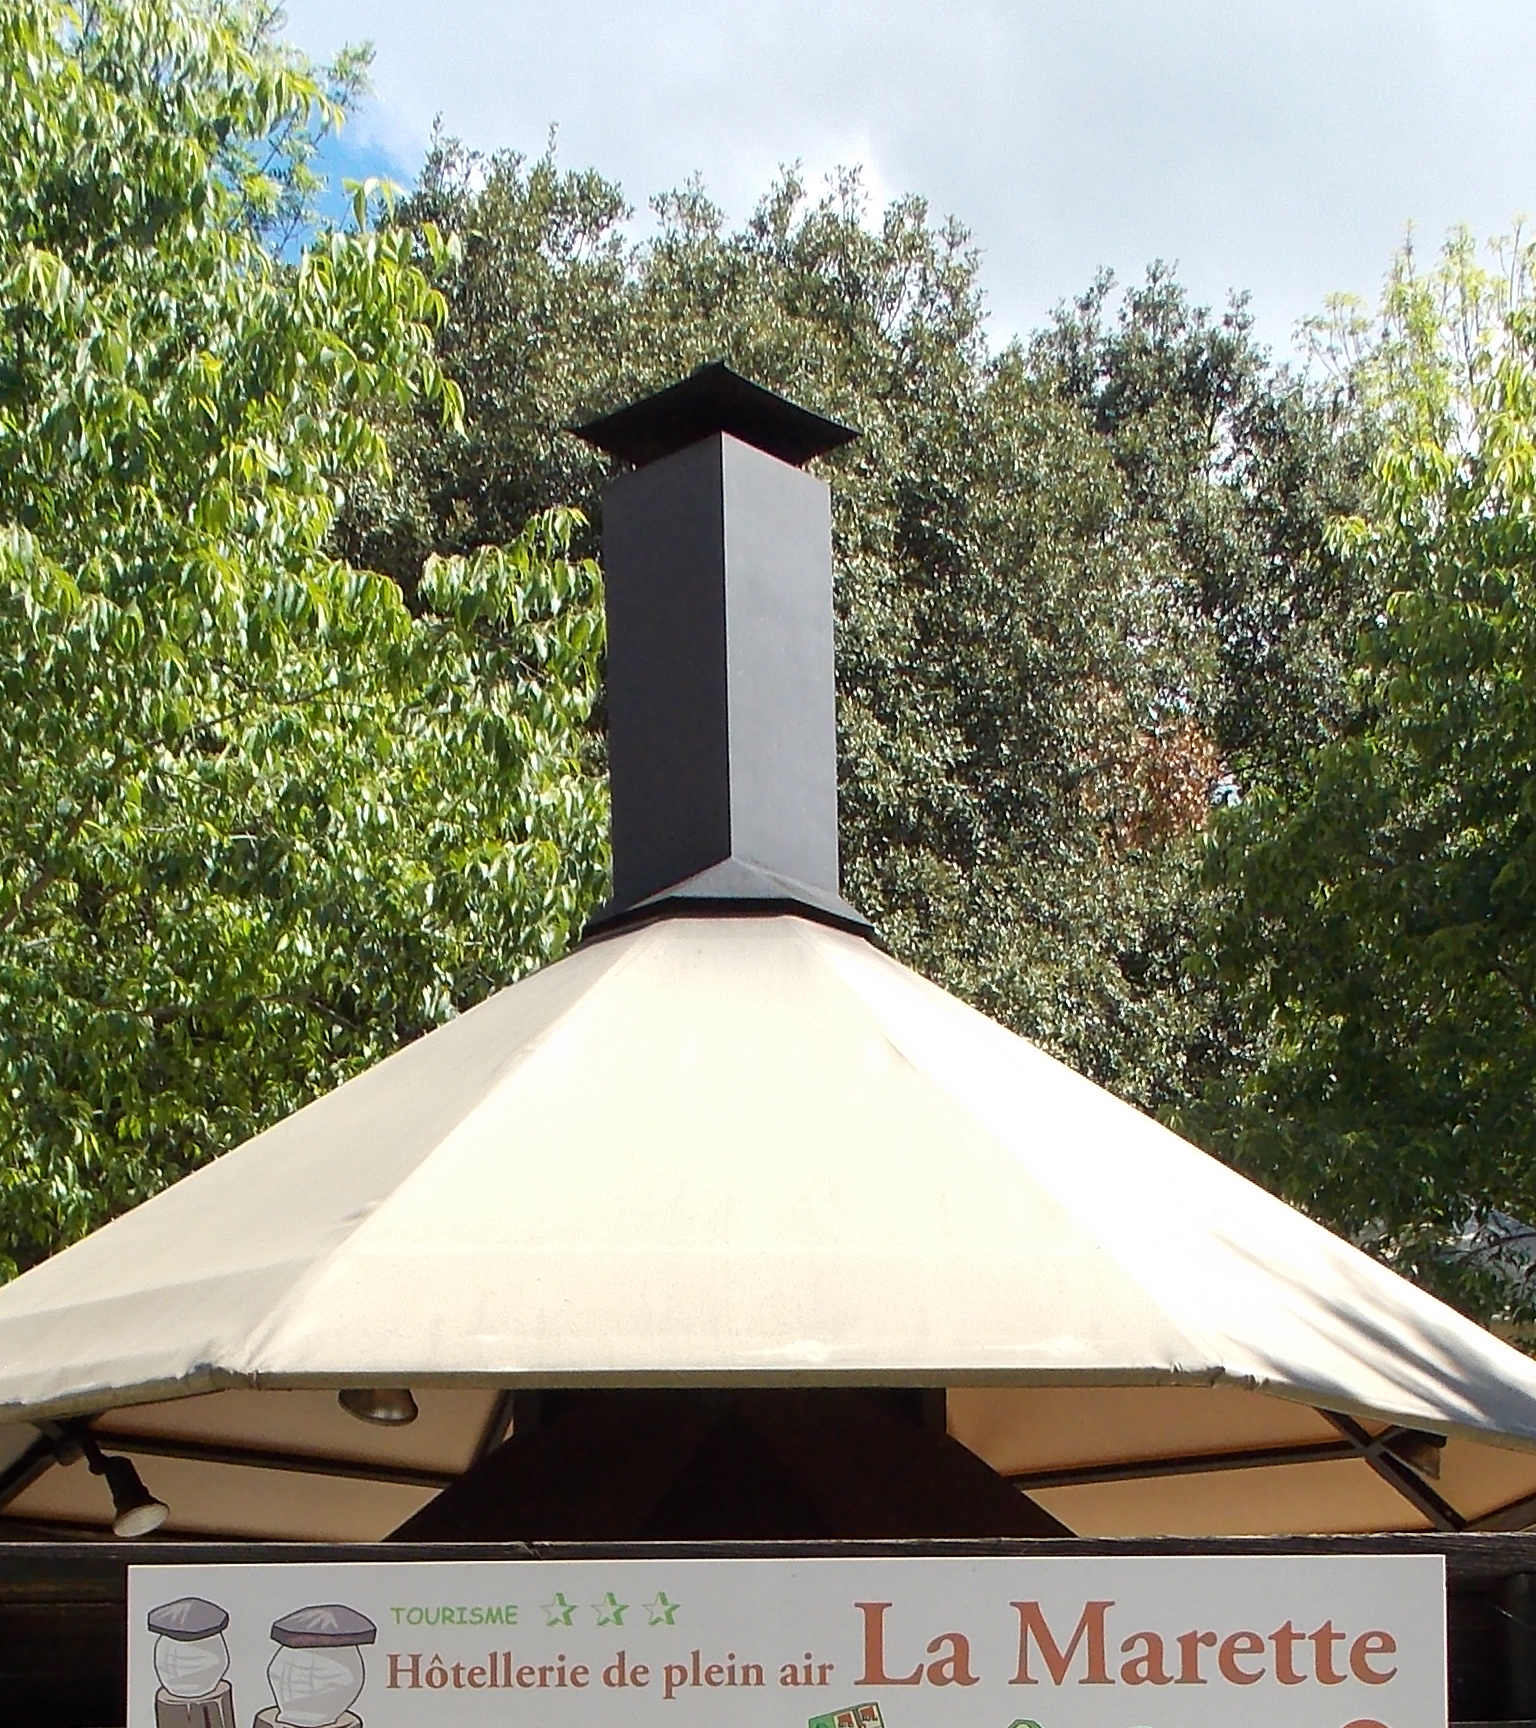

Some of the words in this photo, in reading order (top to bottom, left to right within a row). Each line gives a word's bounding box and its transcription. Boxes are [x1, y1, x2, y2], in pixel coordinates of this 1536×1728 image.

[390, 1606, 518, 1625] TOURISME
[854, 1602, 979, 1686] La
[1008, 1601, 1397, 1686] Marette
[386, 1652, 590, 1689] Hôtellerie
[602, 1652, 649, 1688] de
[662, 1649, 763, 1699] plein
[779, 1652, 834, 1687] air
